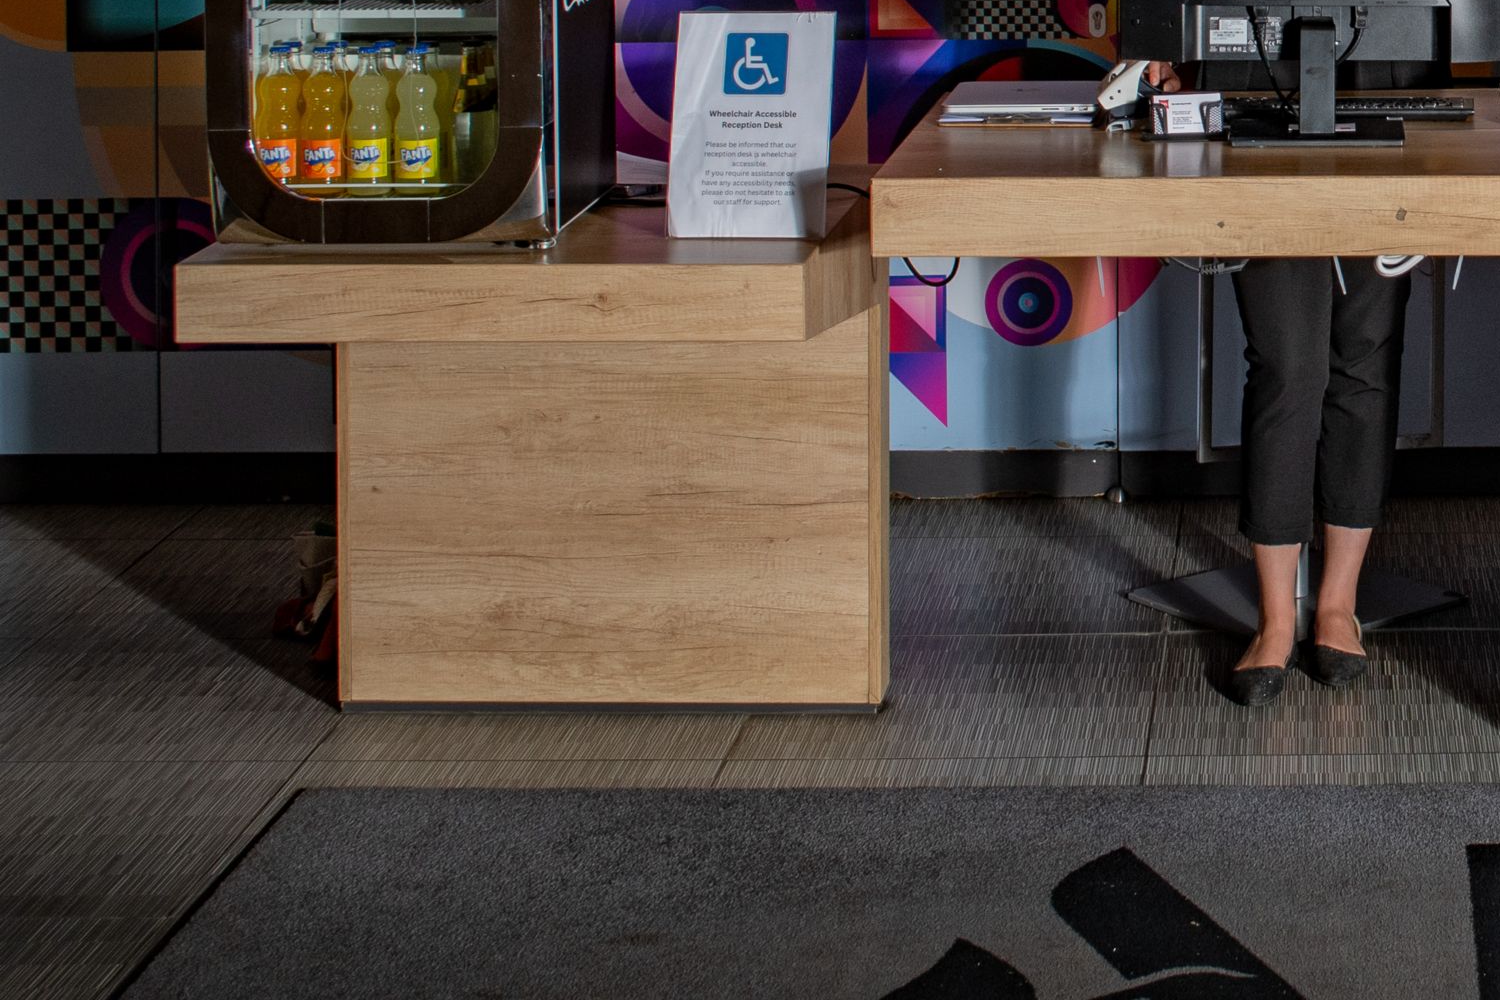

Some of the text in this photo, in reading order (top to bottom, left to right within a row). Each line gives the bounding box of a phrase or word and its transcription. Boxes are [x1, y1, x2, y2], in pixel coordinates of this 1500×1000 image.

[709, 110, 797, 118] Wheelchair Accessible
[721, 121, 783, 130] Reception Desk
[259, 146, 290, 161] FANTA
[304, 146, 336, 161] FANTA
[401, 146, 432, 160] FANTA
[725, 170, 750, 178] require
